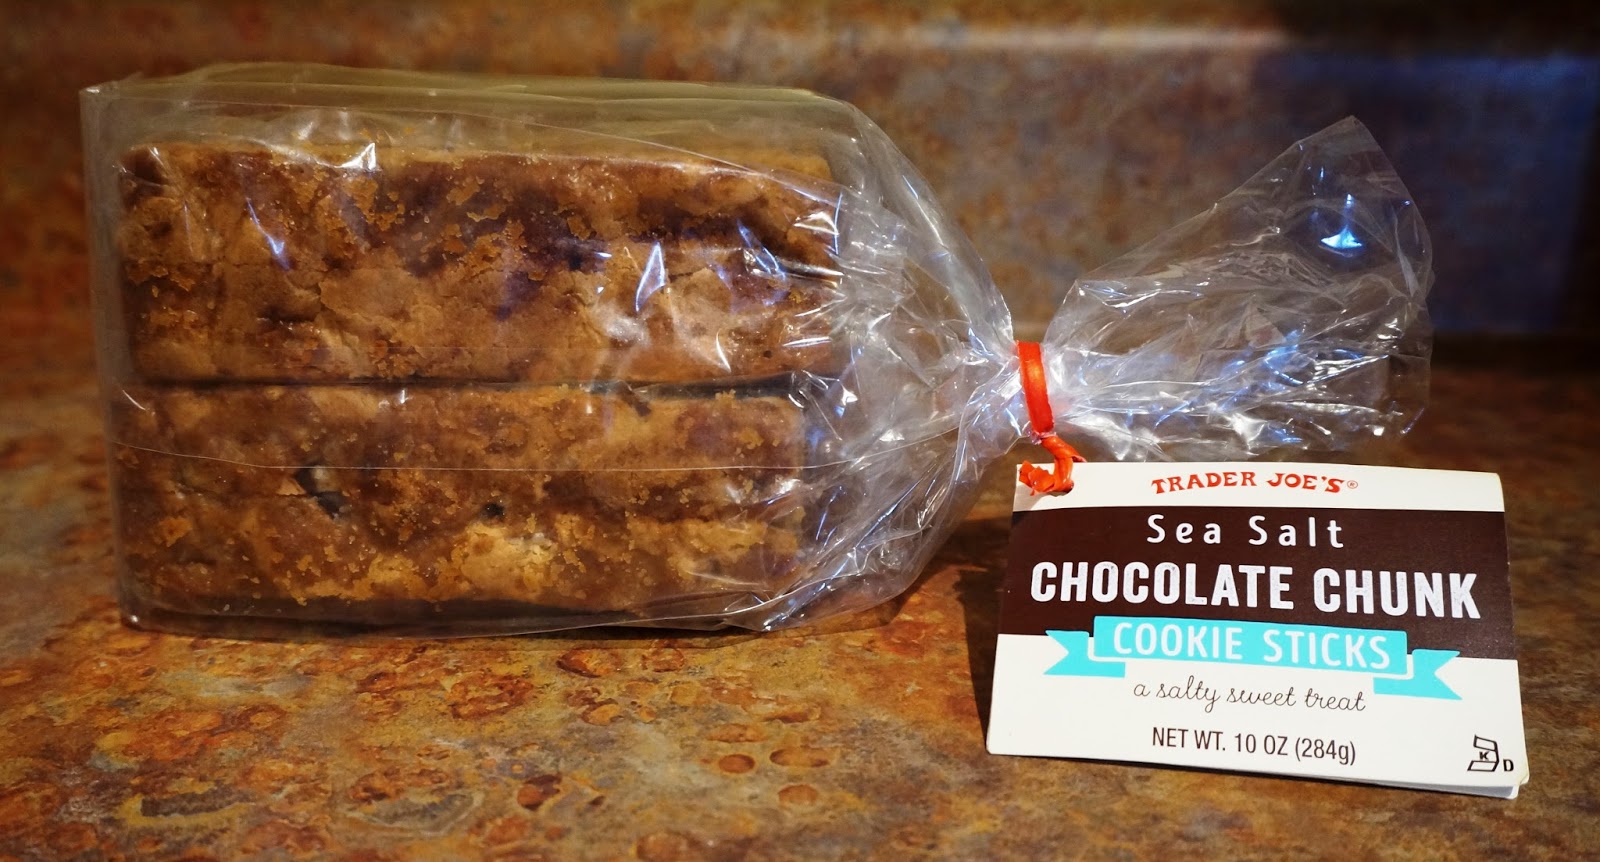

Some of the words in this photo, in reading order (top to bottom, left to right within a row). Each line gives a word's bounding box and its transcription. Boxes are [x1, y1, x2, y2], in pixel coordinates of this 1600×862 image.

[1151, 471, 1257, 494] TRADER
[1147, 513, 1222, 545] Sea
[1248, 514, 1345, 548] Salt
[1030, 561, 1294, 610] CHOCOLATE
[1313, 567, 1482, 619] CHUNK
[1112, 622, 1243, 661] COOKIE
[1263, 630, 1391, 670] STICKS
[1133, 682, 1150, 697] a
[1155, 675, 1221, 713] salty
[1226, 684, 1297, 708] sweet
[1304, 687, 1367, 712] treat
[1152, 726, 1188, 749] NET
[1193, 730, 1227, 752] WT.
[1235, 732, 1257, 754] 10
[1263, 735, 1289, 756] OZ
[1294, 736, 1357, 766] (284g)
[1503, 759, 1514, 772] D
